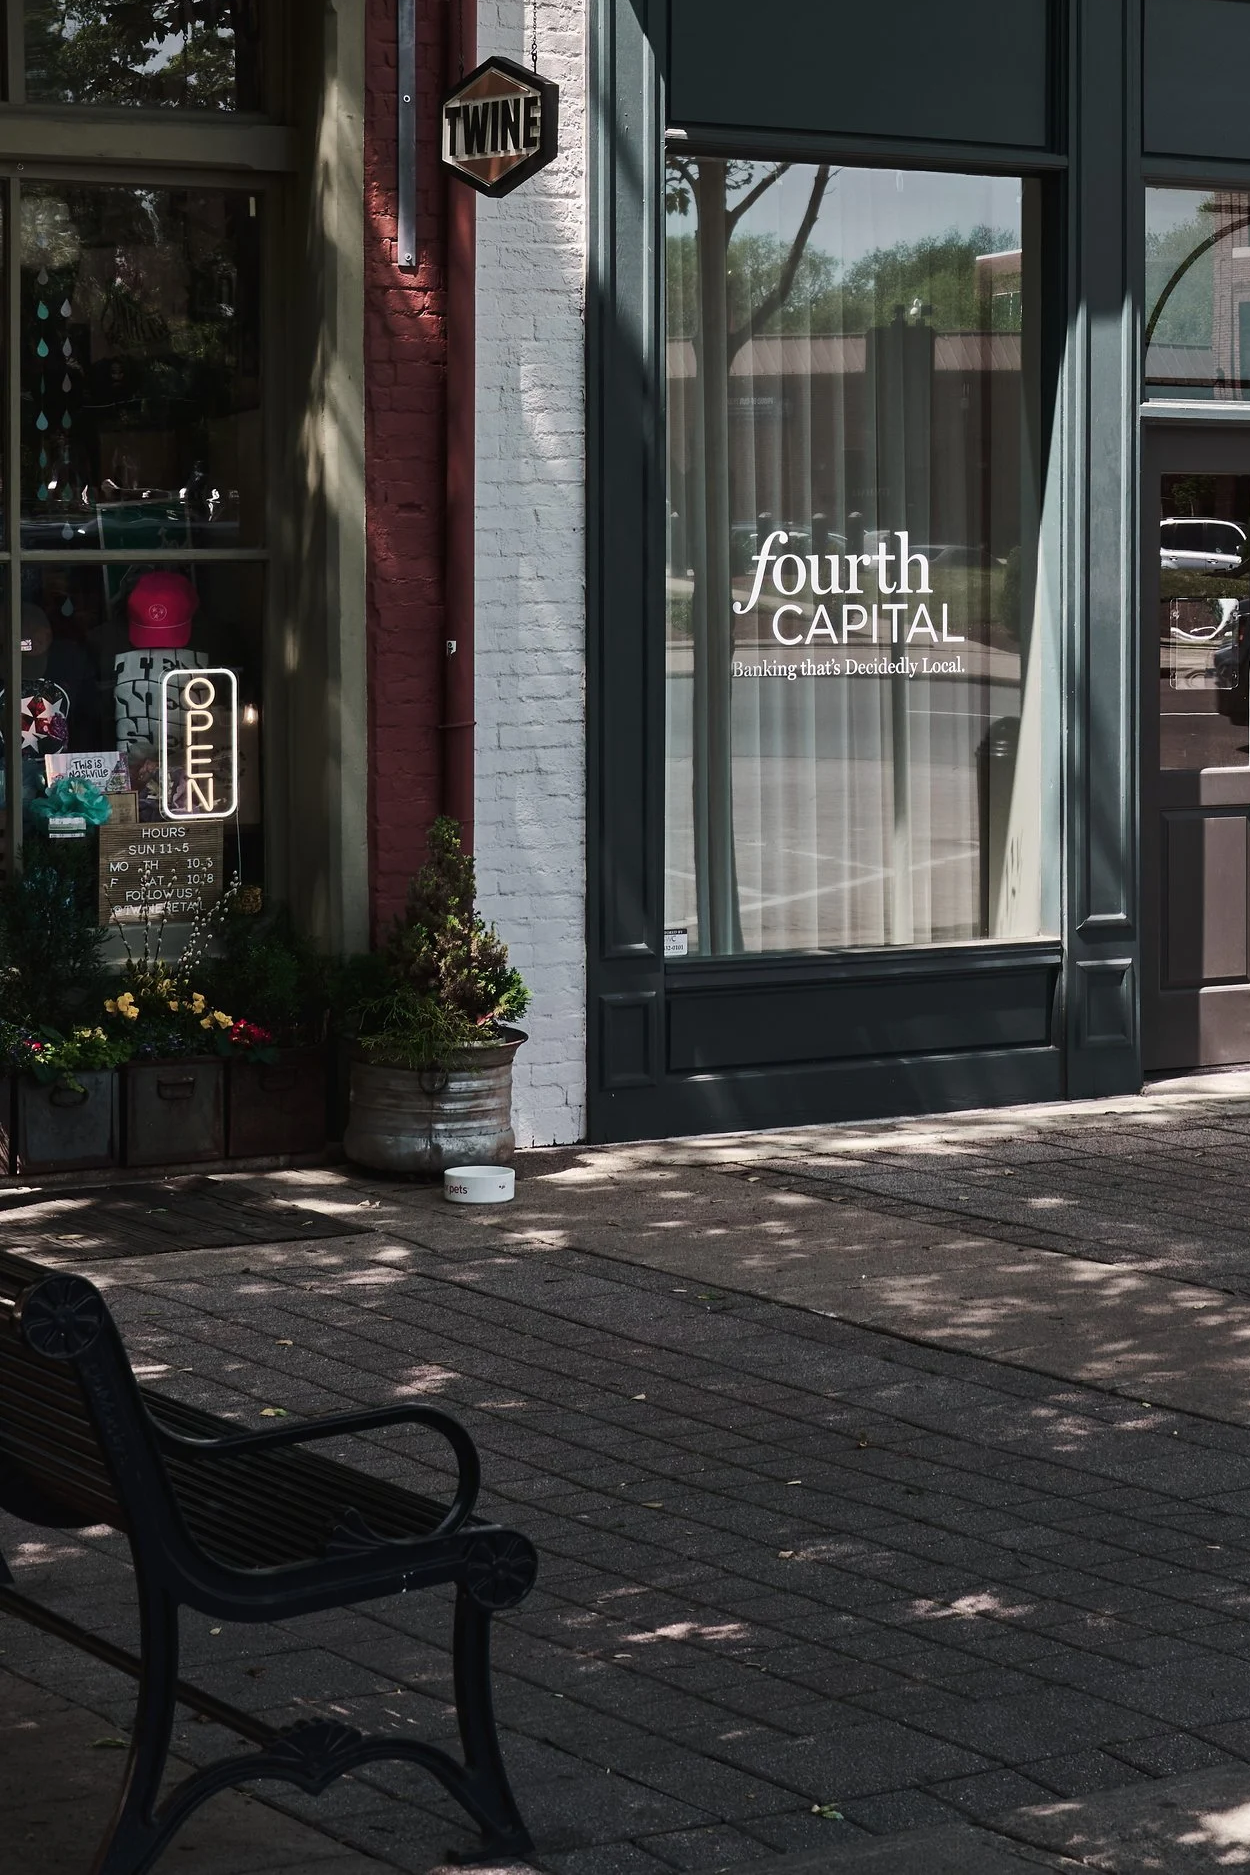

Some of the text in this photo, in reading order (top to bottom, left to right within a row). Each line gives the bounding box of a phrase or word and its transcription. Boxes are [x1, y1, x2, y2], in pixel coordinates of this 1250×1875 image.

[445, 96, 539, 157] TWINE
[732, 530, 933, 615] fourth
[772, 603, 965, 645] CAPITAL
[732, 659, 797, 680] Banking
[845, 656, 918, 678] Decidedly
[921, 655, 965, 674] Local.
[184, 677, 216, 812] OPEN
[73, 758, 103, 770] This is
[142, 827, 186, 838] HOURS
[128, 844, 155, 855] SUN
[109, 861, 129, 872] MO
[125, 888, 193, 902] FOLLOW US
[449, 1184, 468, 1195] pets
